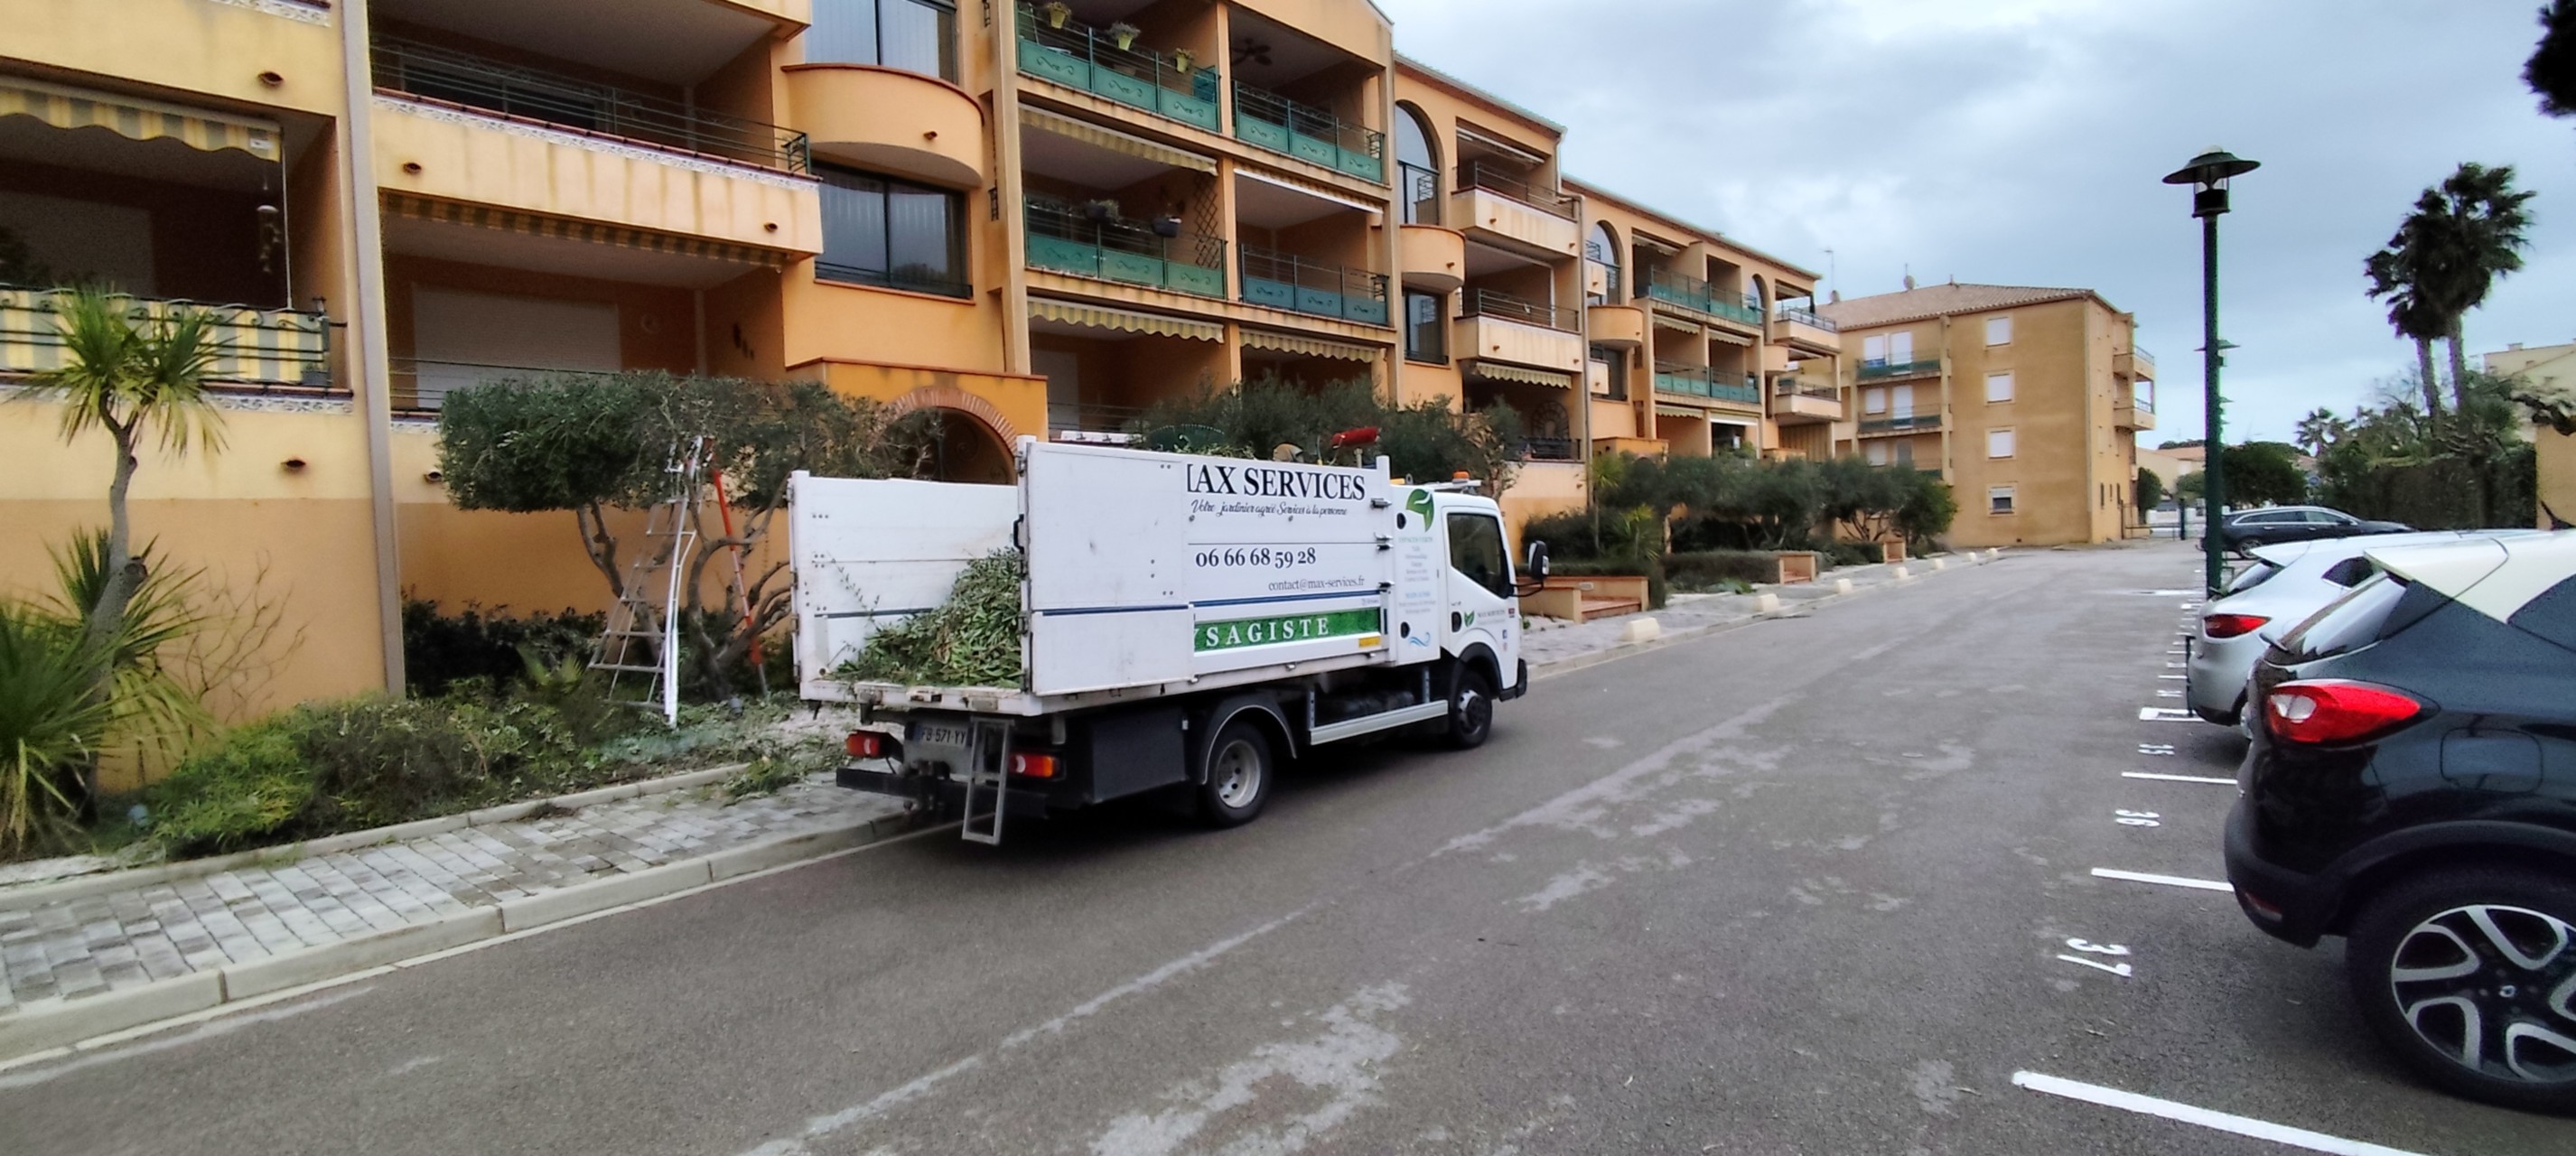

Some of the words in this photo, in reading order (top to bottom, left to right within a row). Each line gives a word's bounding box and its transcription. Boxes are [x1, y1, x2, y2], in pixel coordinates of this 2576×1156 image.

[1244, 467, 1366, 501] SERVICES
[1190, 499, 1215, 514] Votre
[1216, 501, 1255, 517] jardinier
[1276, 501, 1305, 516] Services
[1311, 504, 1320, 515] la
[1320, 507, 1348, 517] personne
[1195, 547, 1219, 567] 06
[1224, 547, 1246, 566] 66
[1249, 547, 1271, 566] 68
[1274, 551, 1293, 569] 59
[1297, 546, 1316, 564] 28
[1268, 574, 1366, 592] contact@max-services.fr
[2114, 809, 2161, 827] 36
[2057, 937, 2132, 977] 37
